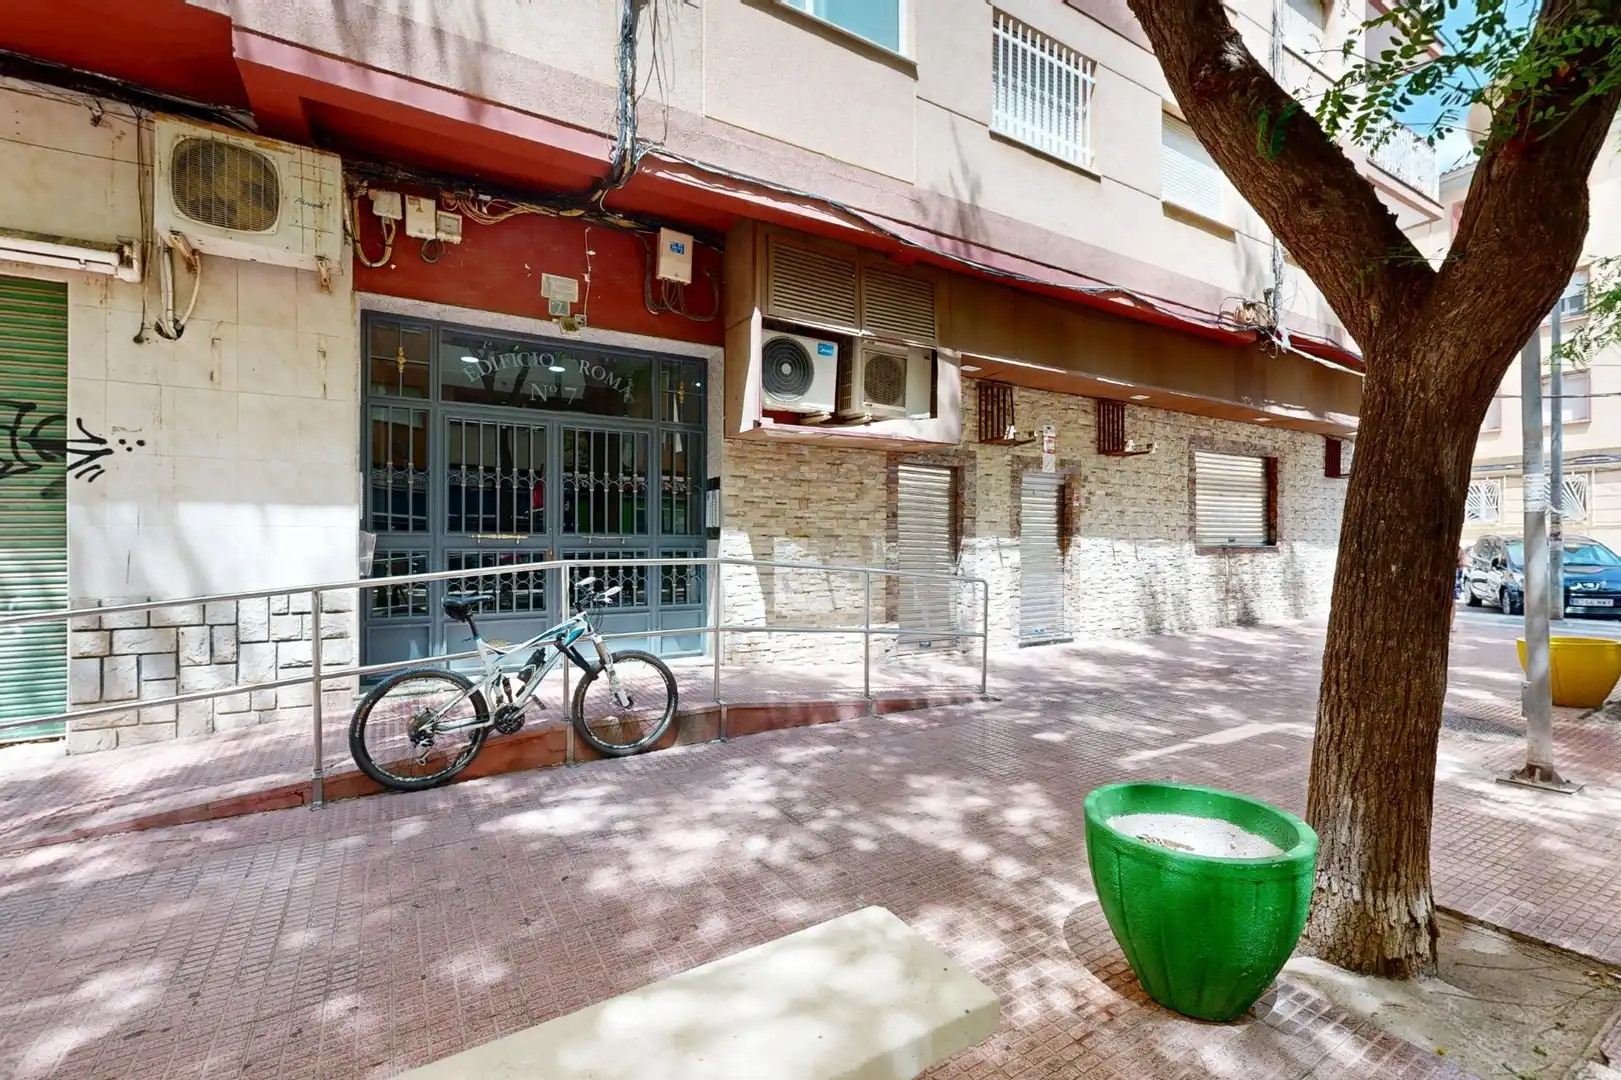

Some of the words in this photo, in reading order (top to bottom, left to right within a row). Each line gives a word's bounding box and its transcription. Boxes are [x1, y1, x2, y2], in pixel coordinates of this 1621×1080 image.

[463, 351, 555, 382] EDIFICIO
[580, 359, 634, 403] ROMA
[564, 387, 577, 405] 7
